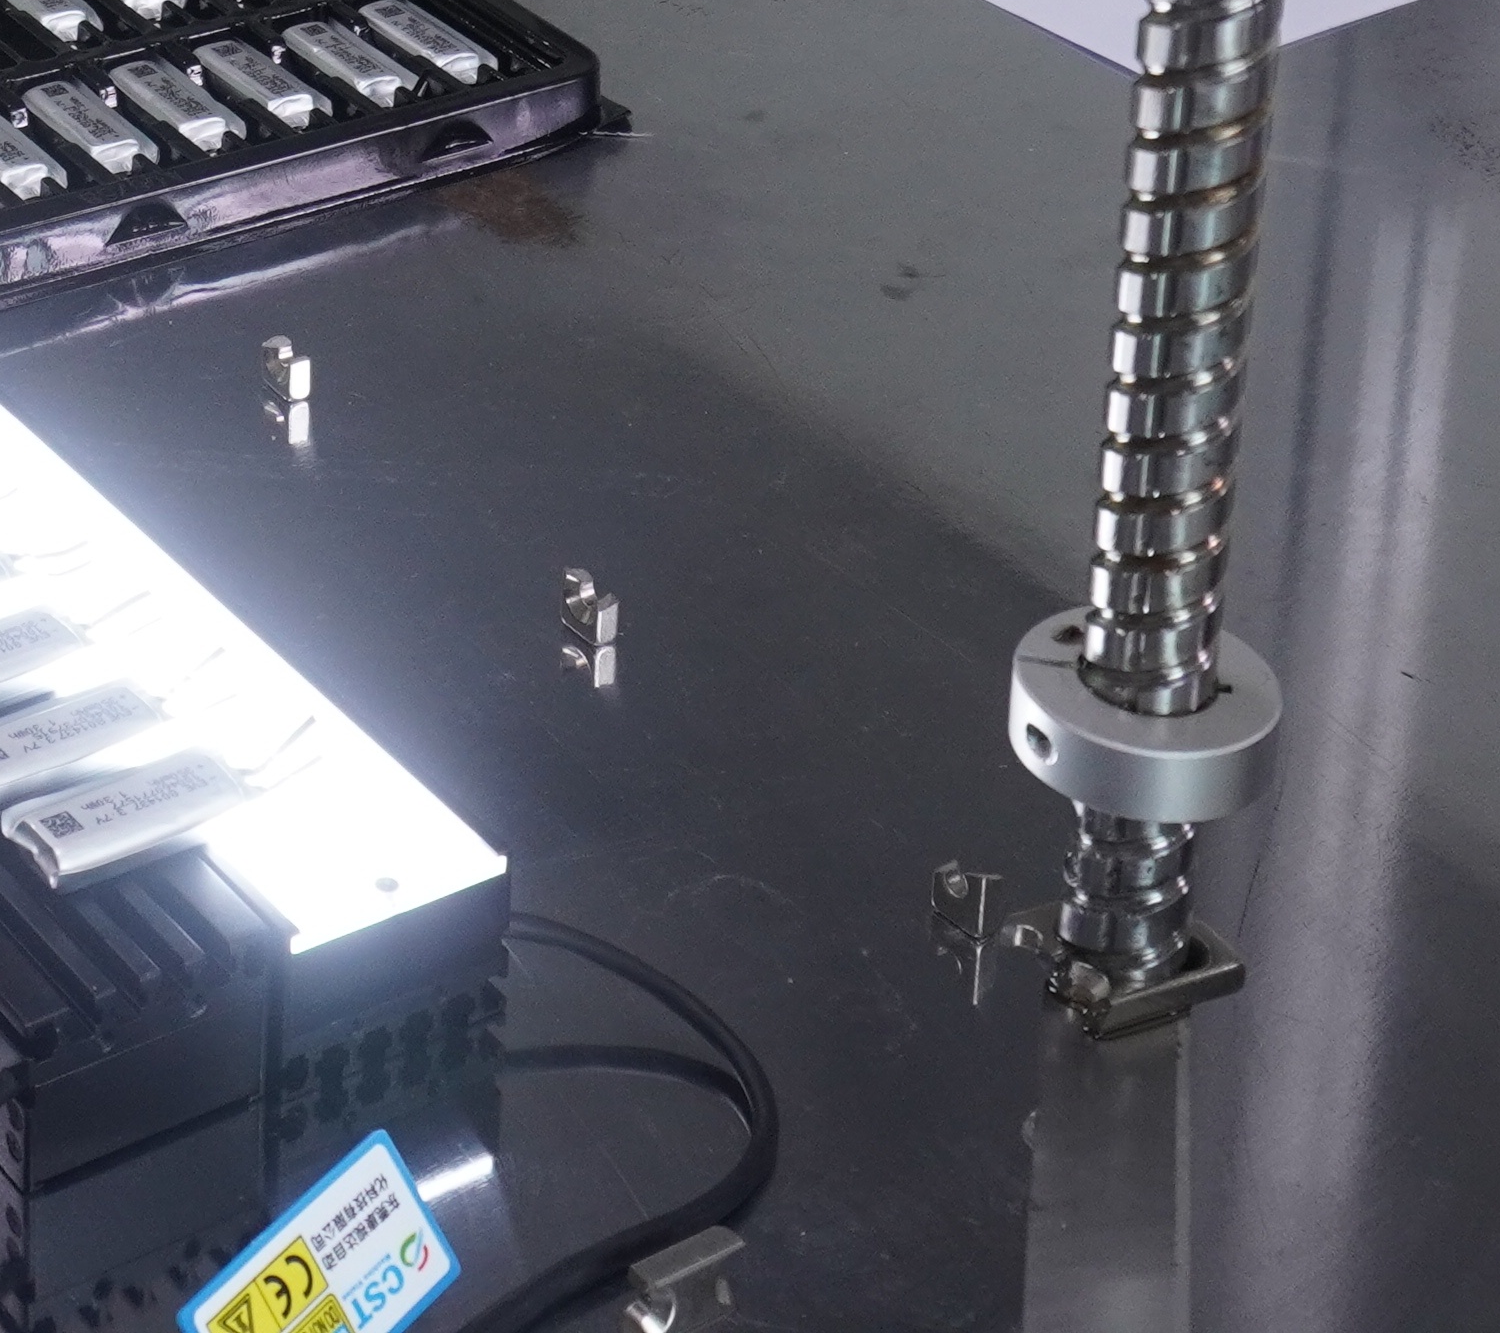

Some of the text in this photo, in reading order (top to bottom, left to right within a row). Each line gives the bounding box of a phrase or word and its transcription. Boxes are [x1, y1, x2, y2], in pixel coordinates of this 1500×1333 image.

[311, 1174, 388, 1251] 化科技有限公司
[321, 1193, 400, 1270] 东莞康视达自动
[351, 1265, 404, 1329] CST
